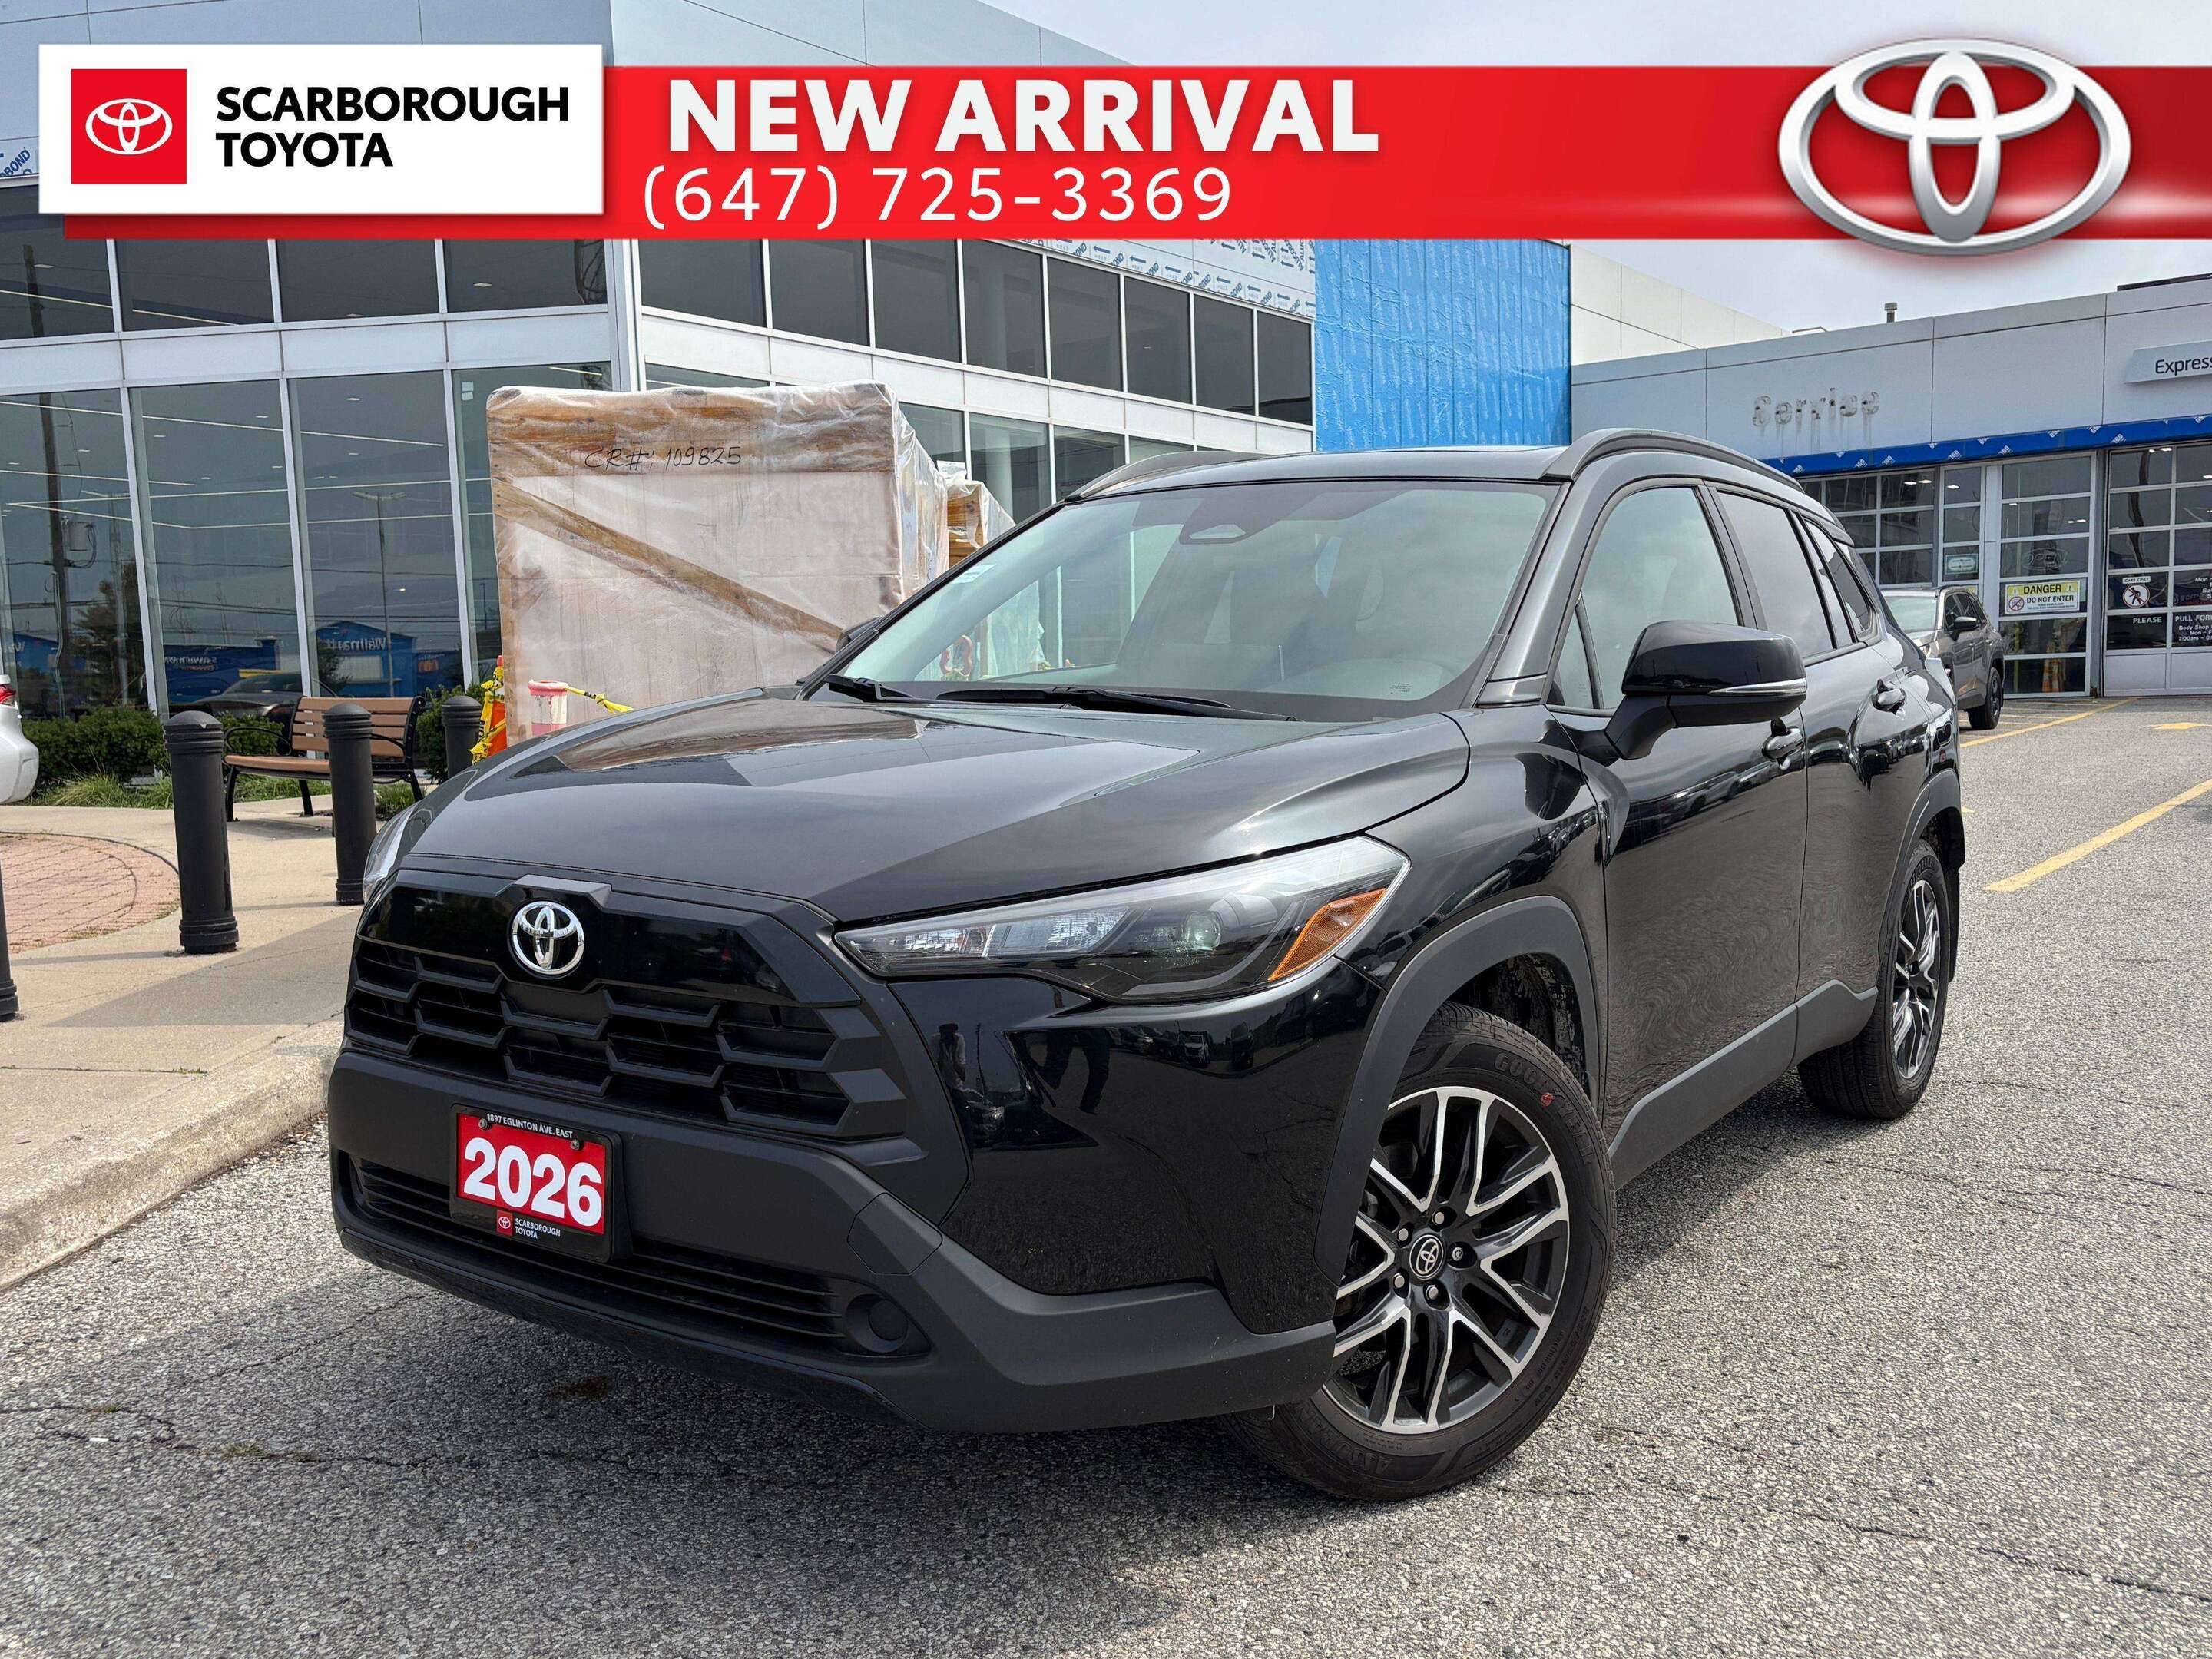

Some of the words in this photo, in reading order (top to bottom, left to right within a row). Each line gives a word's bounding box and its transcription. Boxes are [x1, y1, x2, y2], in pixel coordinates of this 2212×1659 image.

[665, 445, 741, 470] 109825
[2023, 584, 2061, 594] DANGER
[2133, 616, 2162, 624] PLEASE
[487, 1113, 502, 1124] 1897
[503, 1117, 538, 1131] EGLINTON
[539, 1124, 555, 1135] AVE.
[555, 1128, 573, 1139] EAST
[463, 1137, 603, 1227] 2026
[515, 1217, 561, 1237] SCARBOROUGH
[515, 1226, 538, 1239] TOYOTA
